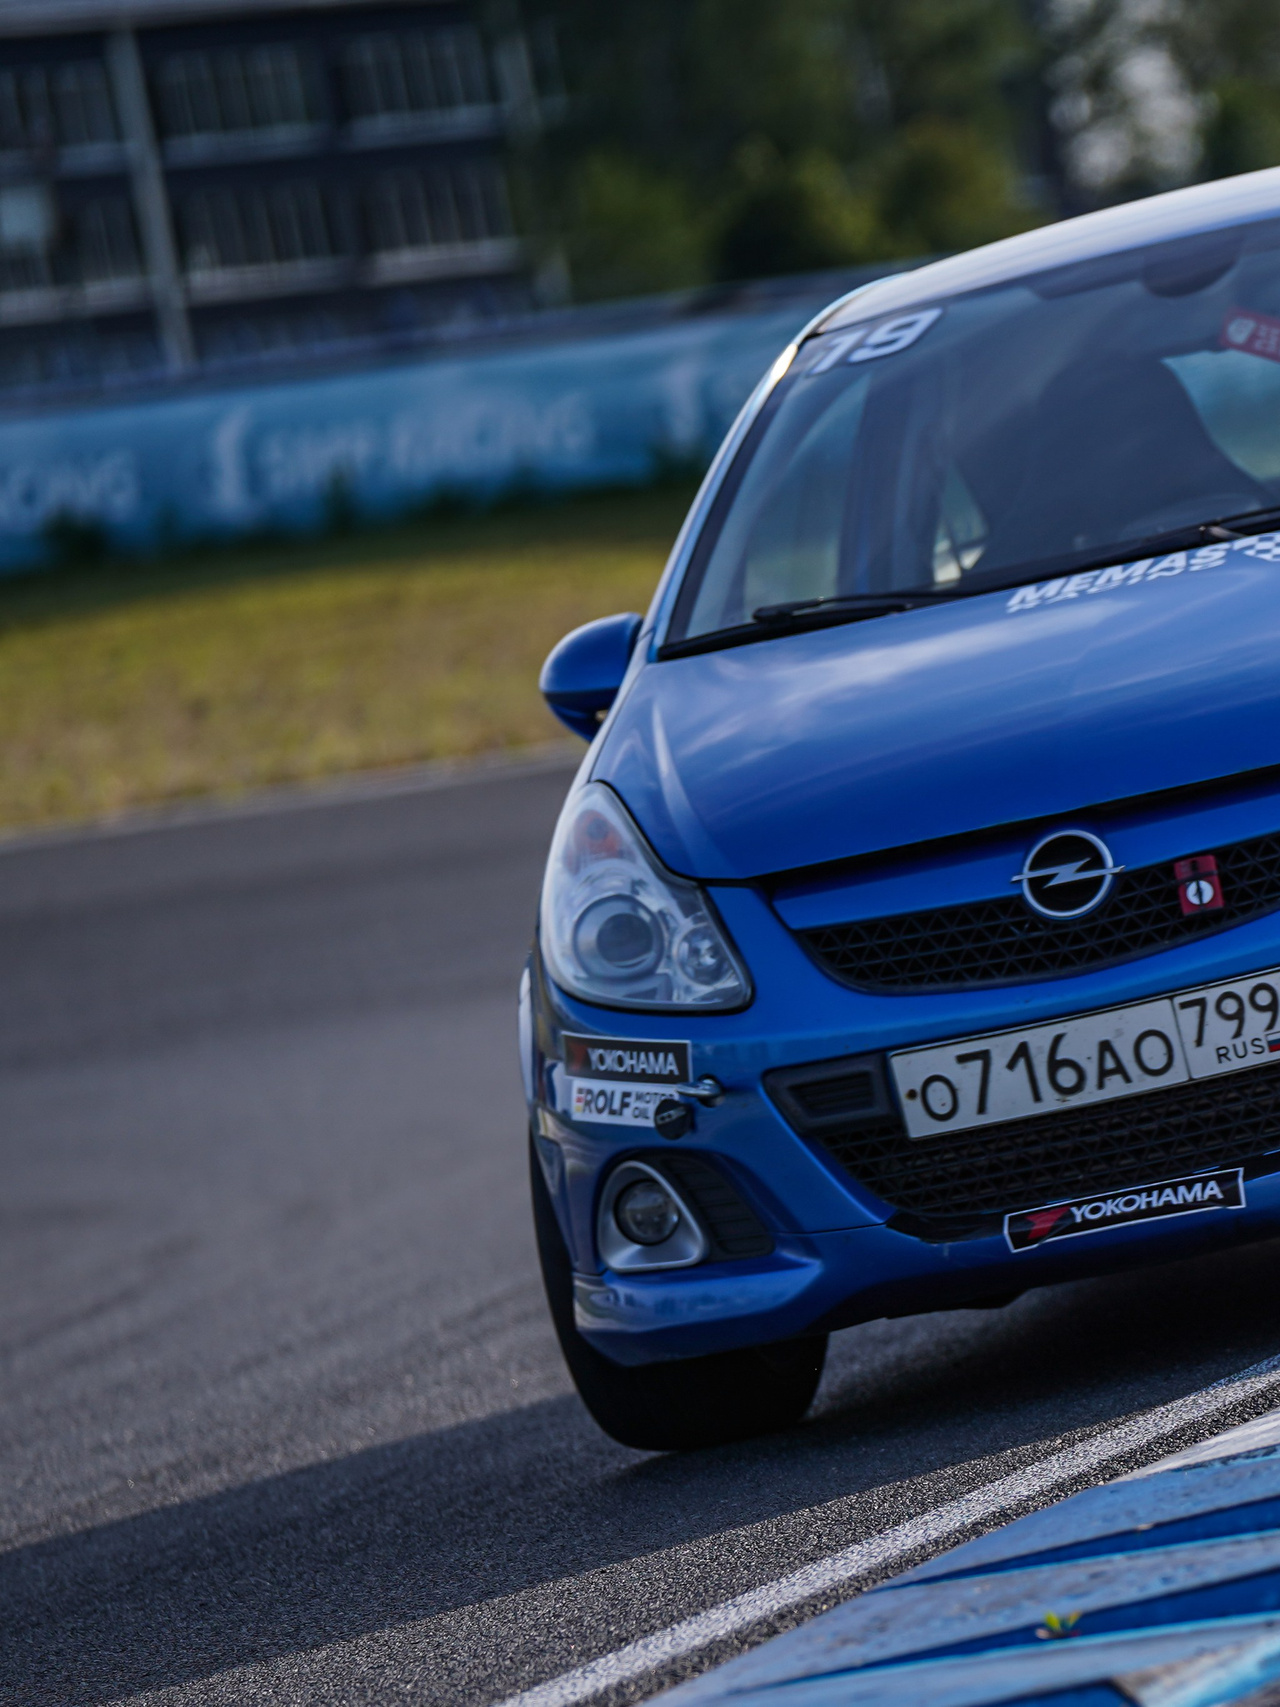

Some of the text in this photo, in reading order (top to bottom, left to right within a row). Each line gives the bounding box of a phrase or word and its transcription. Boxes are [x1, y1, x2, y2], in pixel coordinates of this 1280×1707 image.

[811, 307, 944, 375] 19
[1006, 541, 1232, 607] MEMAS
[1179, 982, 1280, 1048] 799
[588, 1047, 680, 1076] YOKOHAMA
[1216, 1038, 1266, 1065] RUS
[584, 1088, 632, 1116] ROLF
[1070, 1180, 1224, 1223] YOKOHAMA
